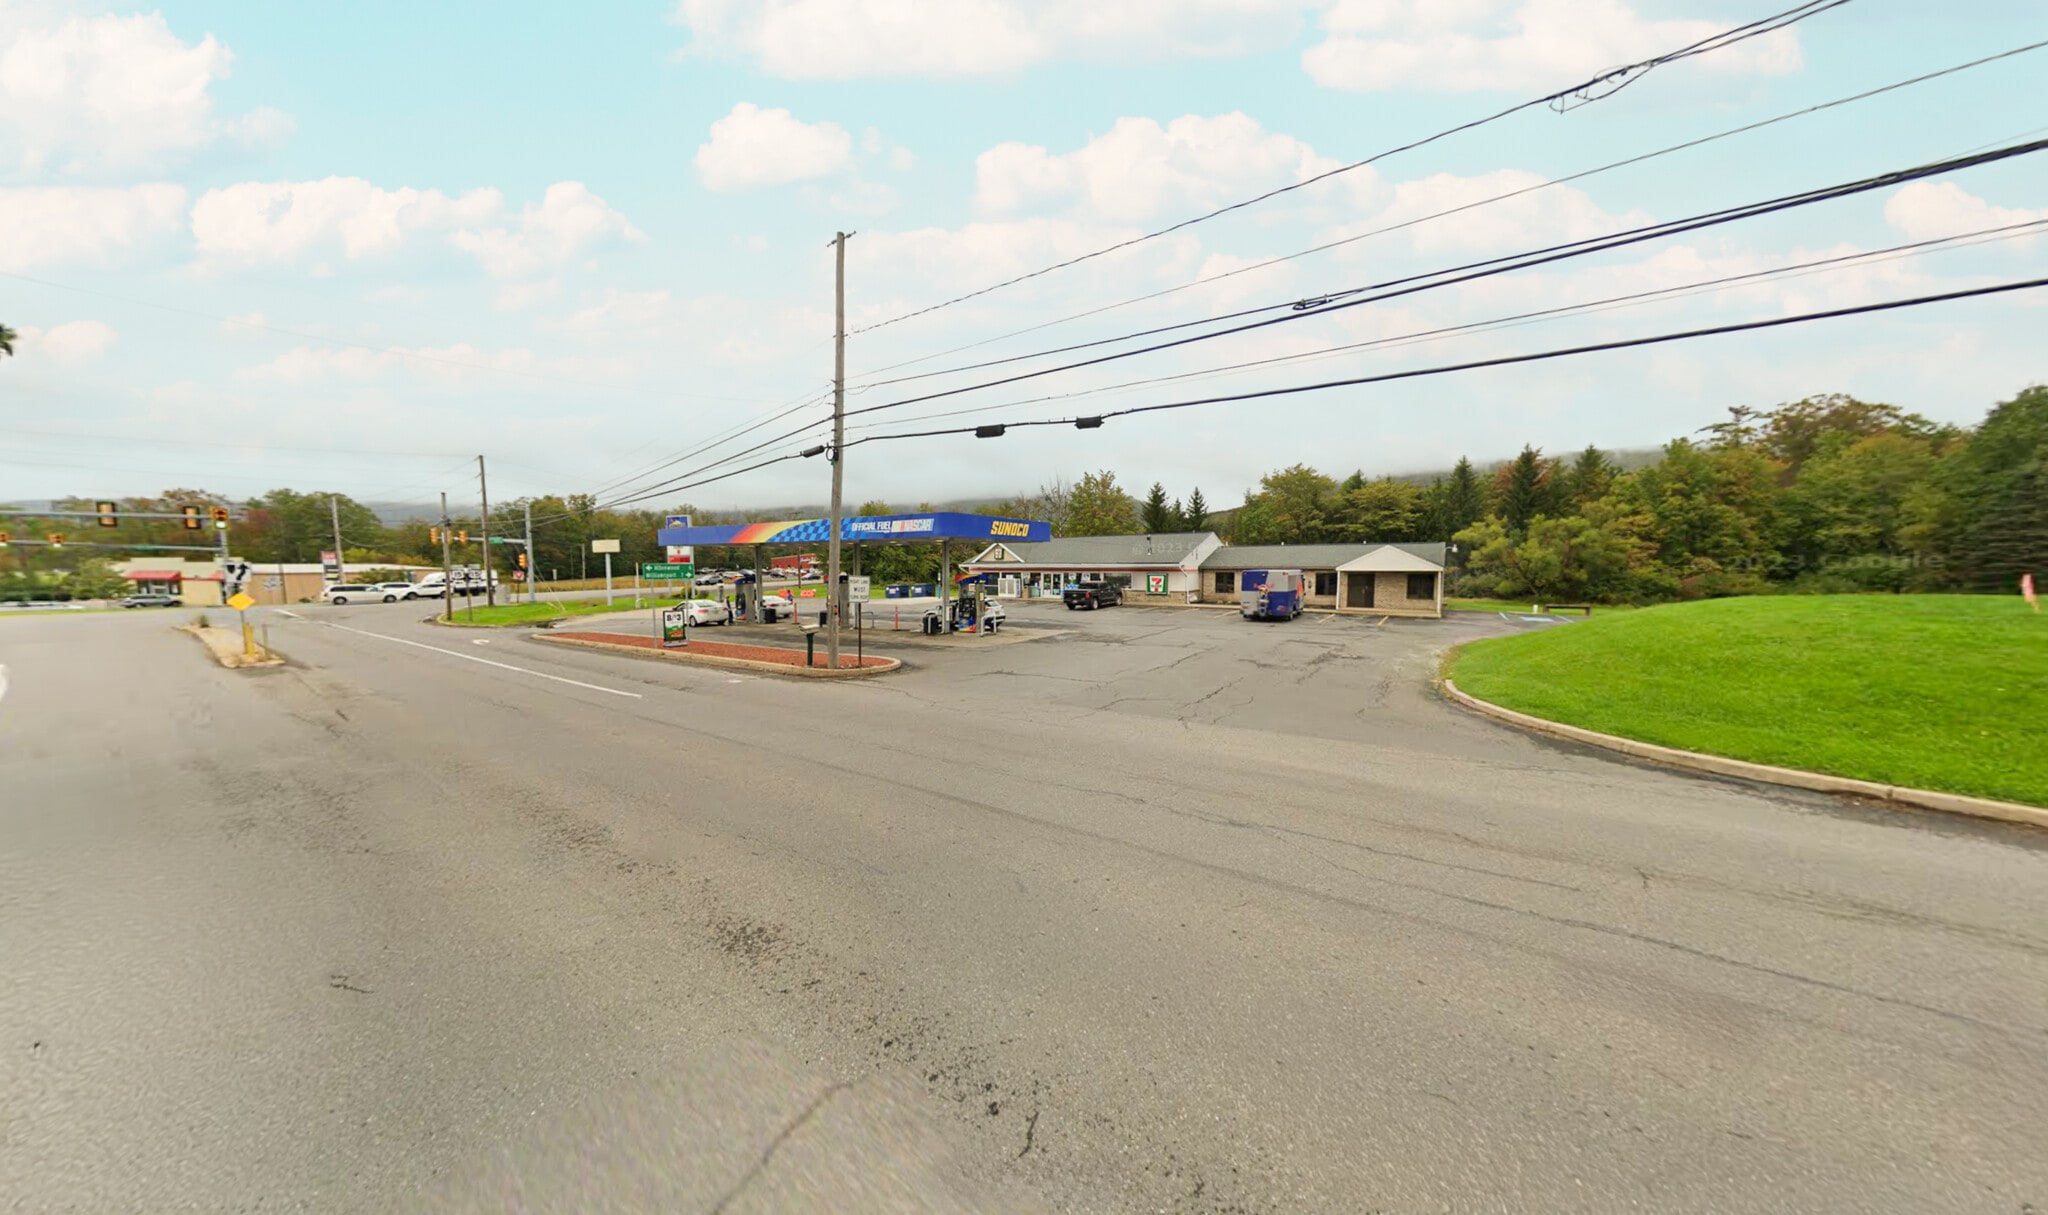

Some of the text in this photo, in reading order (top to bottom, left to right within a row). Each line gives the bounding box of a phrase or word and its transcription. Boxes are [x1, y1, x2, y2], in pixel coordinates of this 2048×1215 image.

[852, 520, 891, 531] OFFICIAL FUEL
[903, 519, 933, 531] NASCAR
[990, 520, 1029, 537] SUNOCO
